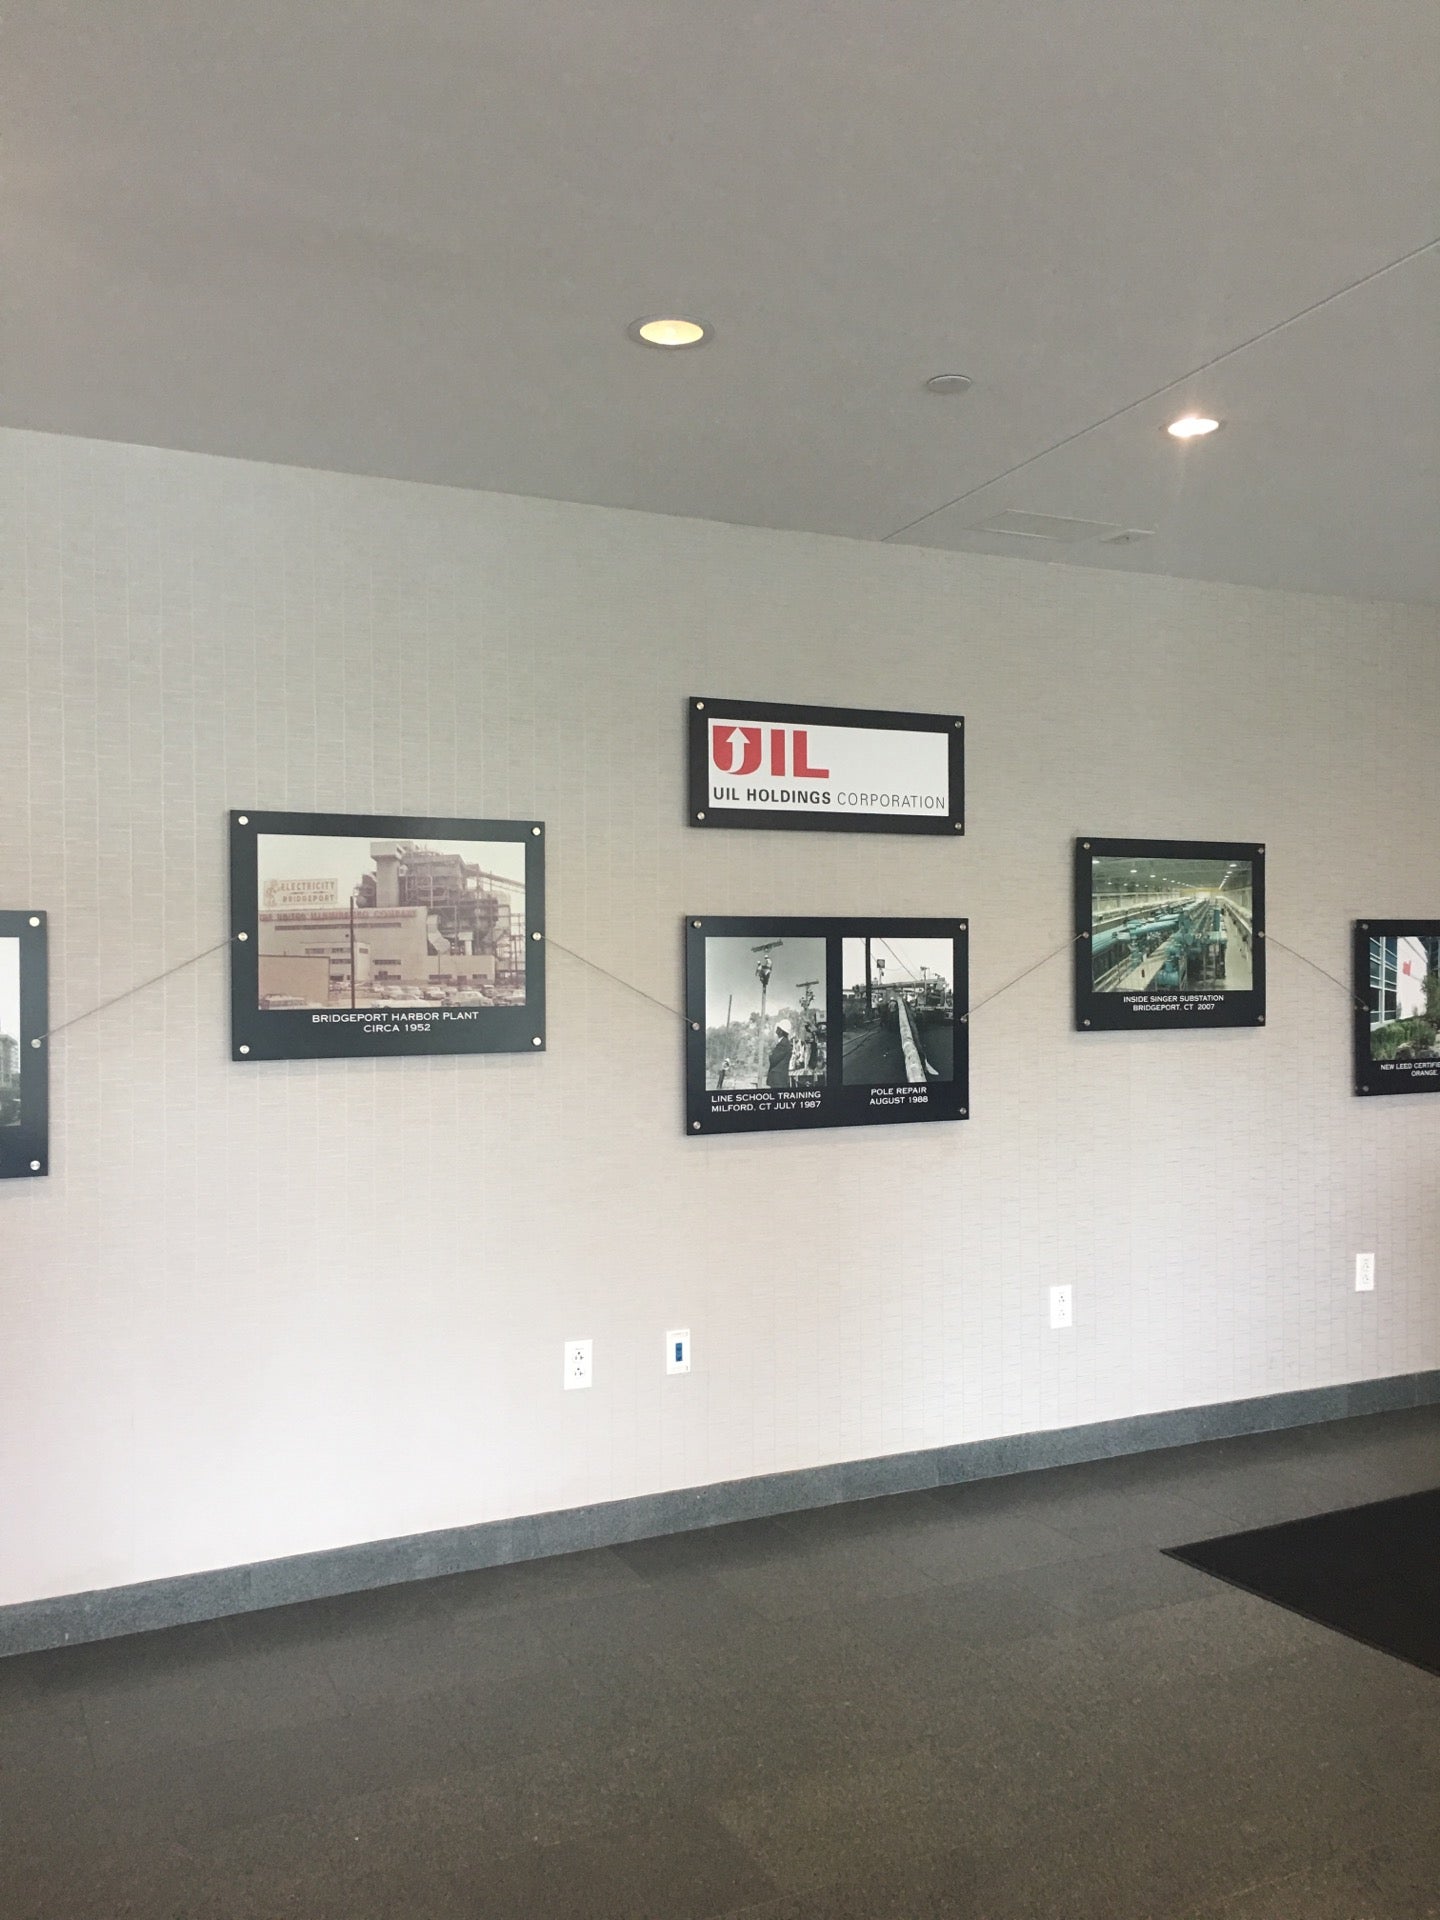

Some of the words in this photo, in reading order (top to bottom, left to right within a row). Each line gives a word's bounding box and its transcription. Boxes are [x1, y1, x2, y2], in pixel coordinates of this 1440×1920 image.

[713, 725, 829, 779] UIL
[713, 787, 740, 801] UIL
[746, 788, 831, 805] HOLDINGS
[837, 791, 945, 809] CORPORATION
[1123, 995, 1149, 1003] INSIDE
[1150, 995, 1178, 1003] SINGER
[1179, 994, 1224, 1002] SUBSTATION
[1183, 1003, 1194, 1011] CT
[1197, 1003, 1215, 1011] 2007
[312, 1013, 388, 1023] BRIDGEPORT
[391, 1012, 440, 1021] HARBOR
[442, 1011, 479, 1020] PLANT
[363, 1024, 400, 1033] CIRCA
[404, 1023, 431, 1032] 1952
[711, 1094, 734, 1103] LINE
[735, 1092, 775, 1102] SCHOOL
[777, 1090, 822, 1100] TRAINING
[870, 1087, 894, 1096] POLE
[896, 1086, 927, 1095] REPAIR
[758, 1102, 772, 1111] CT
[773, 1101, 797, 1110] JULY
[800, 1100, 822, 1109] 1987
[869, 1096, 906, 1106] AUGUST
[908, 1095, 929, 1103] 1988
